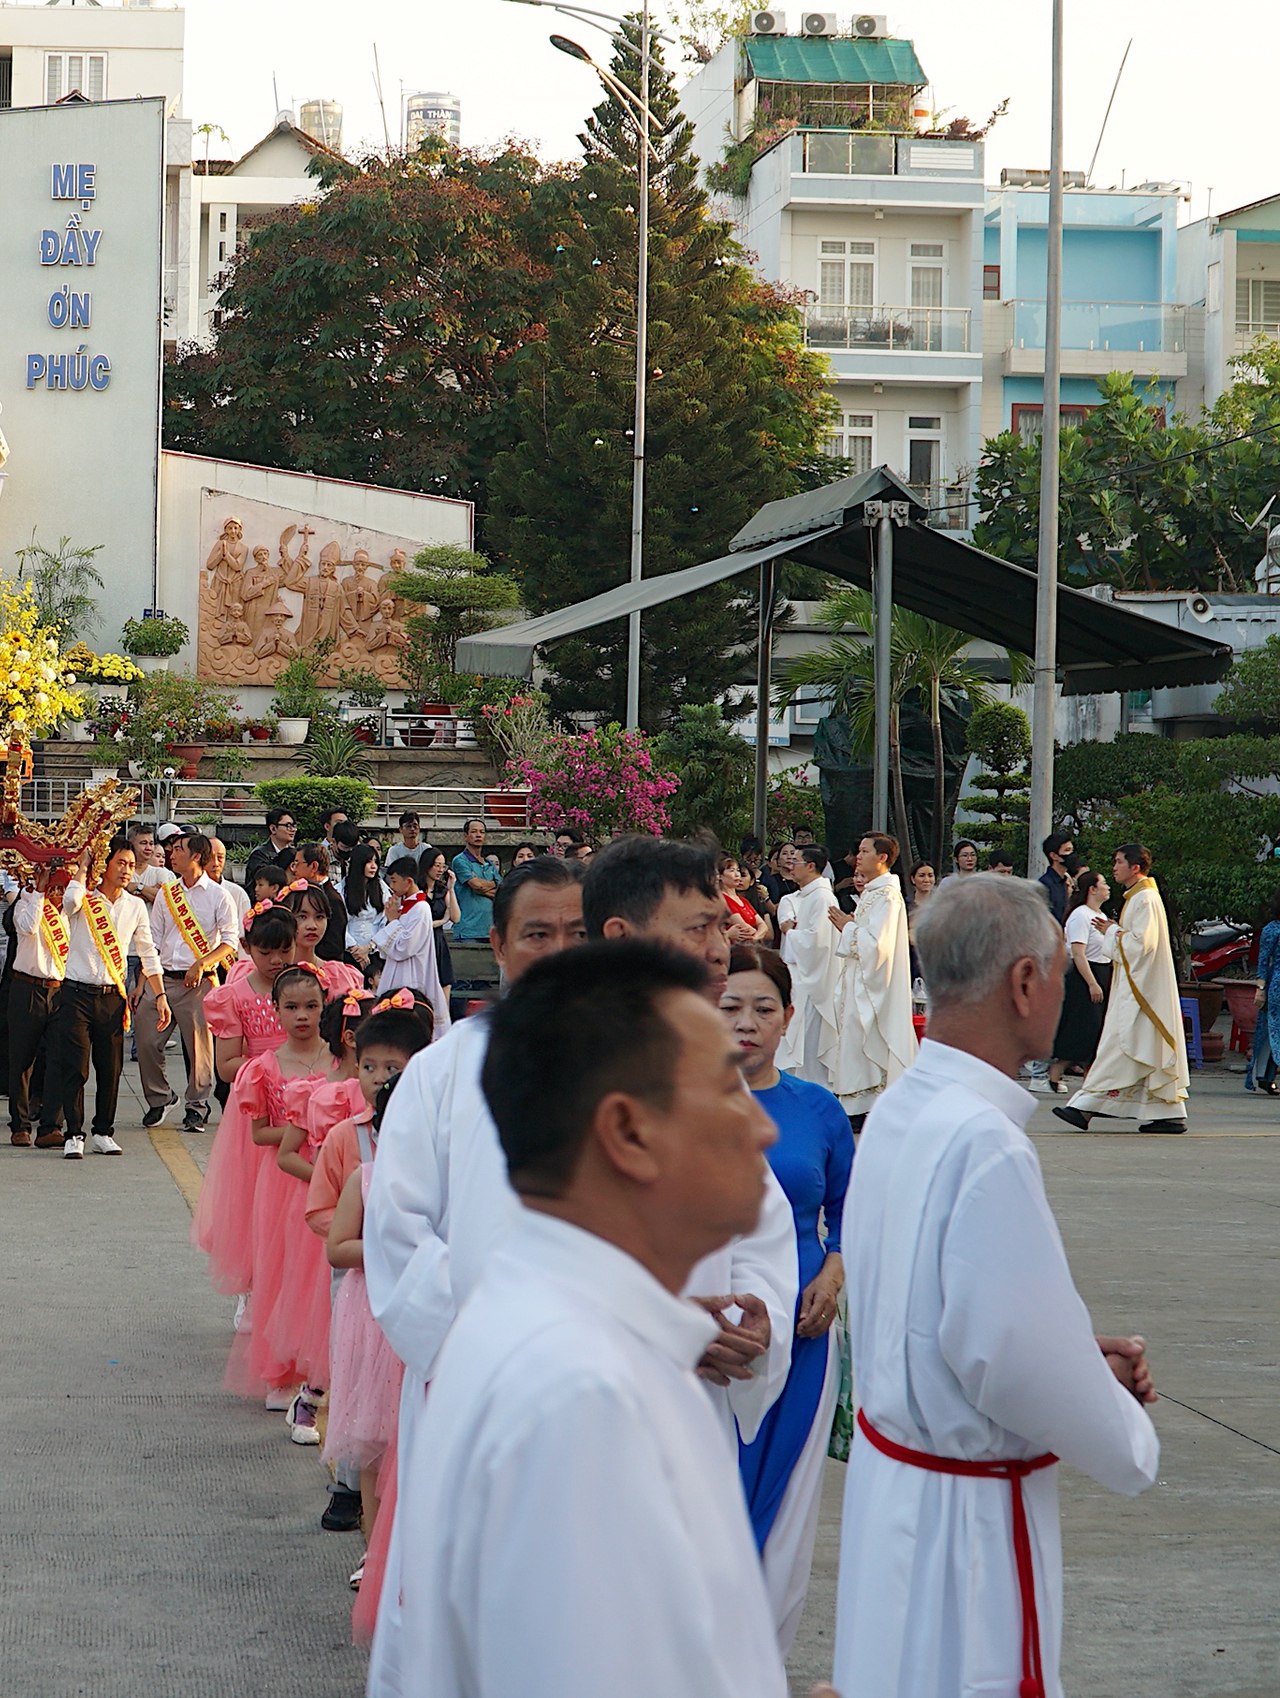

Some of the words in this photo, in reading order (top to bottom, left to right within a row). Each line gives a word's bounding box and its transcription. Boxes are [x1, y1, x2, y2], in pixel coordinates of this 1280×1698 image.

[51, 163, 97, 211] MẸ
[39, 213, 103, 266] ĐẦY
[47, 283, 91, 329] ƠN
[25, 344, 111, 391] PHÚC
[43, 904, 59, 927] GIÁO
[52, 927, 64, 942] HỌ
[95, 915, 109, 930] HỌ
[102, 930, 116, 946] MẸ
[183, 916, 196, 931] MẸ
